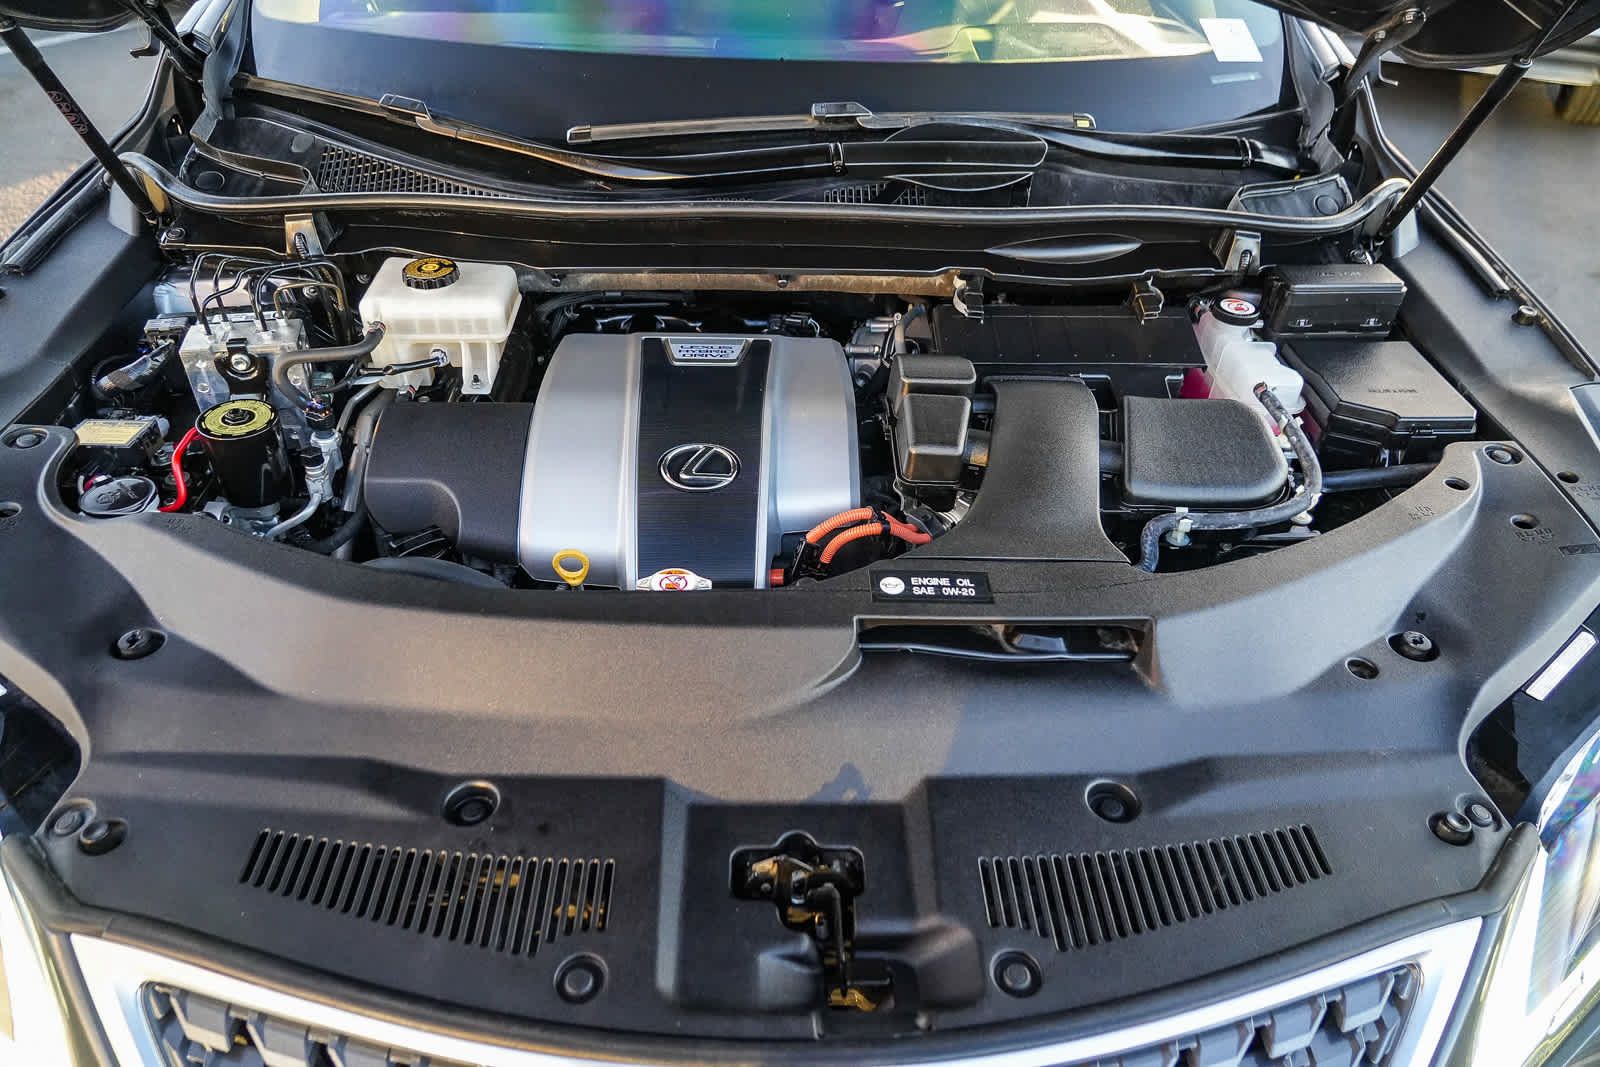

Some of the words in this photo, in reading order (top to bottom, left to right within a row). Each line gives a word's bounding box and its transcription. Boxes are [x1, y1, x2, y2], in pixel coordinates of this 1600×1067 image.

[910, 577, 951, 586] ENGINE
[956, 578, 975, 587] OIL
[912, 587, 936, 595] SAE
[942, 587, 976, 596] 0W-20
